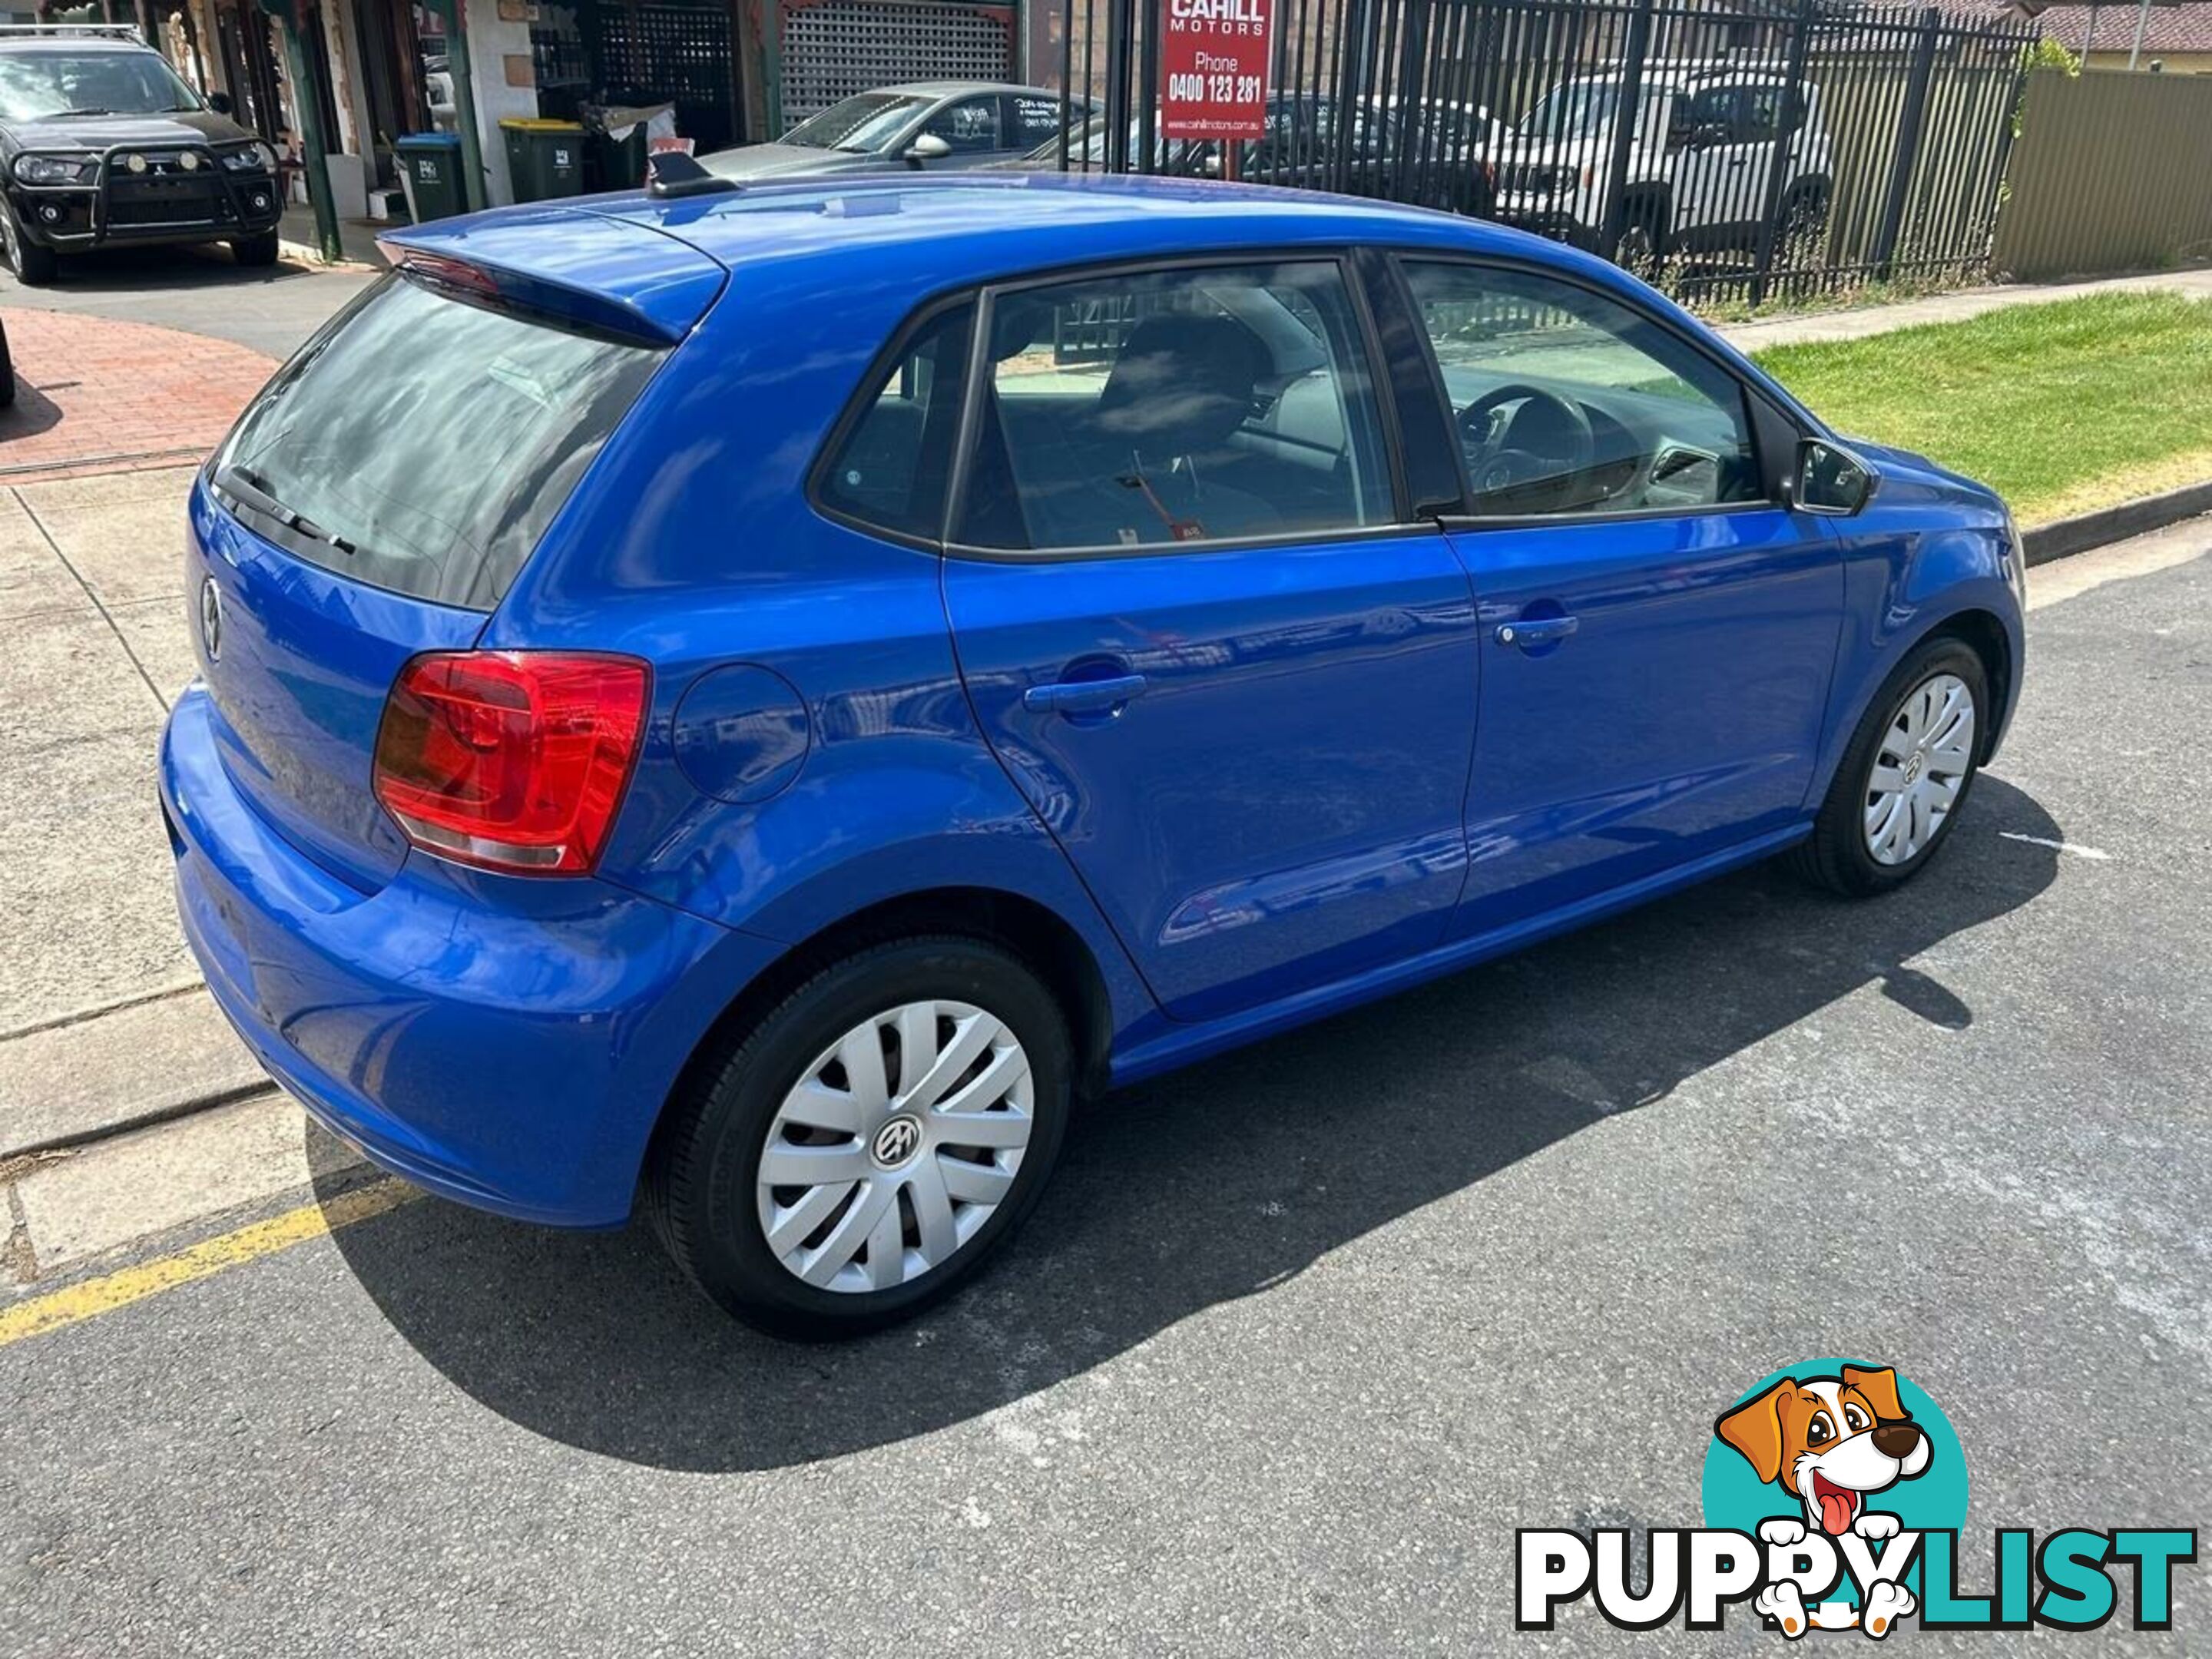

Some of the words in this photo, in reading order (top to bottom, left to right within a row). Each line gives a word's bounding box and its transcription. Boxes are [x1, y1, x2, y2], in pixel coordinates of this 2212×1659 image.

[1171, 0, 1264, 22] CAHILL
[1171, 19, 1263, 35] MOTORS
[1195, 51, 1238, 72] Phone
[1169, 74, 1204, 101] 0400
[1207, 75, 1233, 103] 123
[1237, 76, 1260, 103] 281
